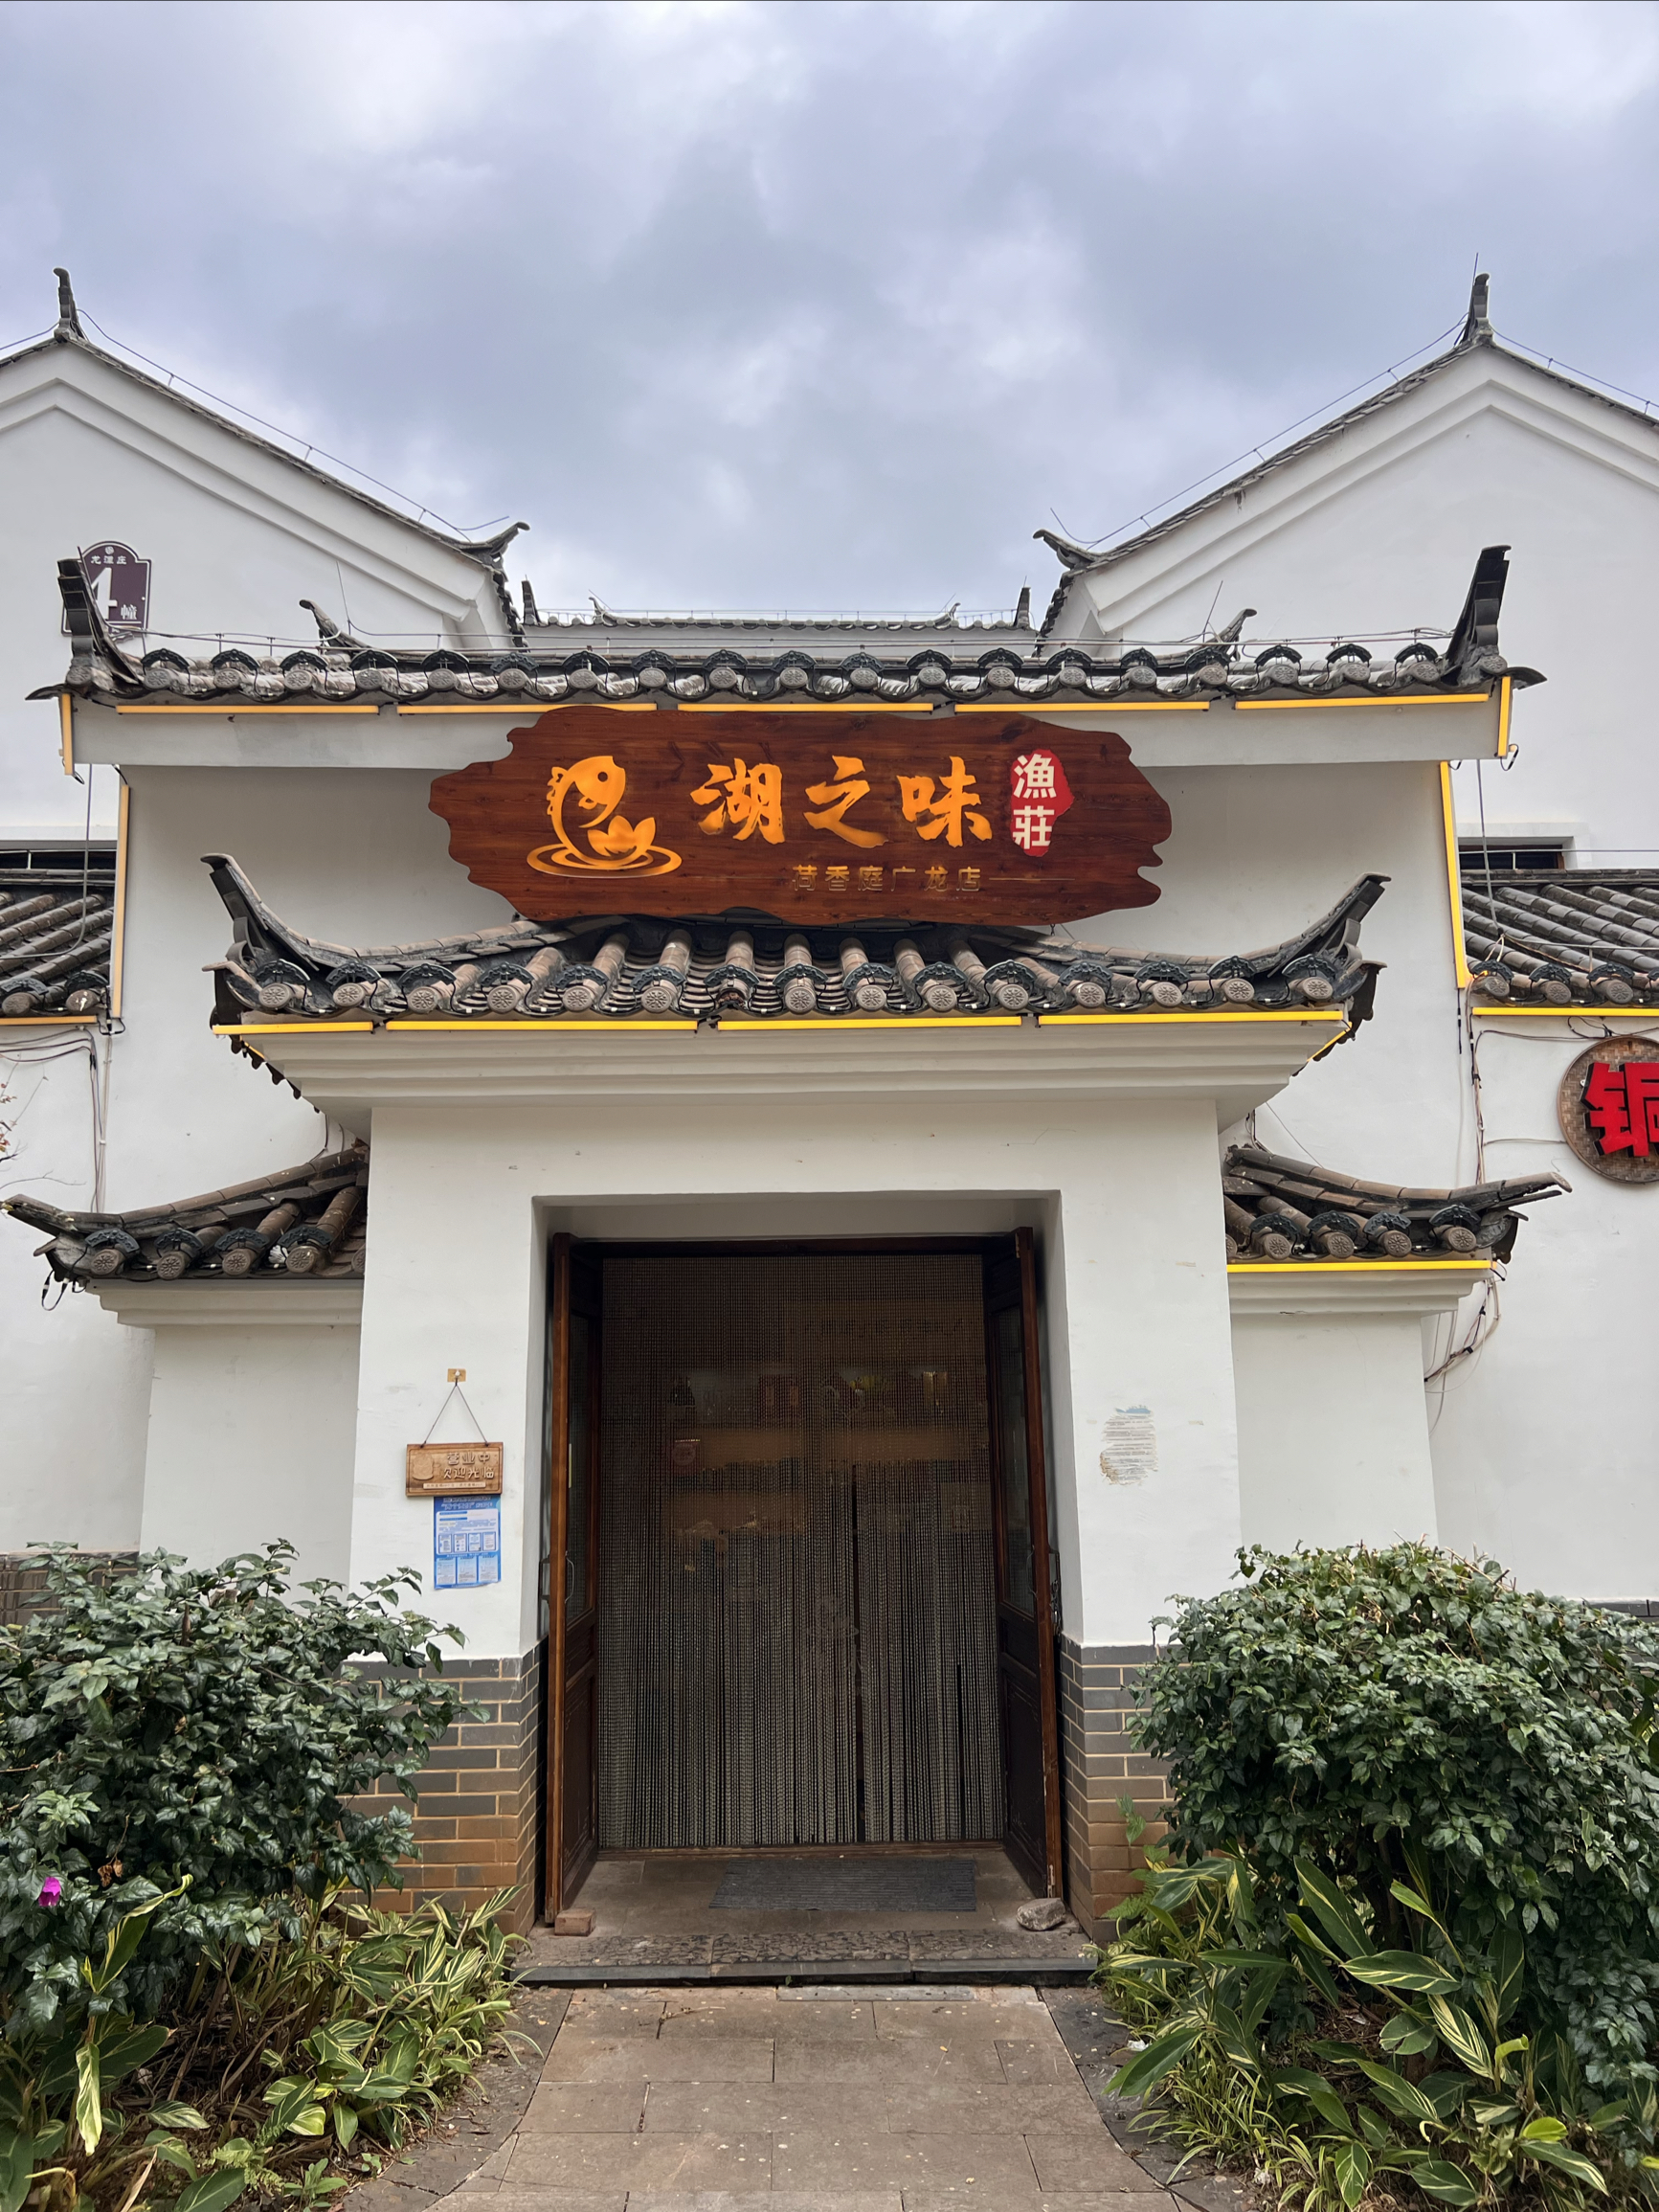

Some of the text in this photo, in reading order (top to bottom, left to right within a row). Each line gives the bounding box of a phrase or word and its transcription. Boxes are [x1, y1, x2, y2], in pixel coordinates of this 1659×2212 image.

[91, 567, 118, 620] 4
[690, 756, 992, 848] 湖之味
[1013, 754, 1057, 849] 漁莊
[792, 865, 981, 892] 荷香庭广龙店
[447, 1452, 490, 1465] 营业中
